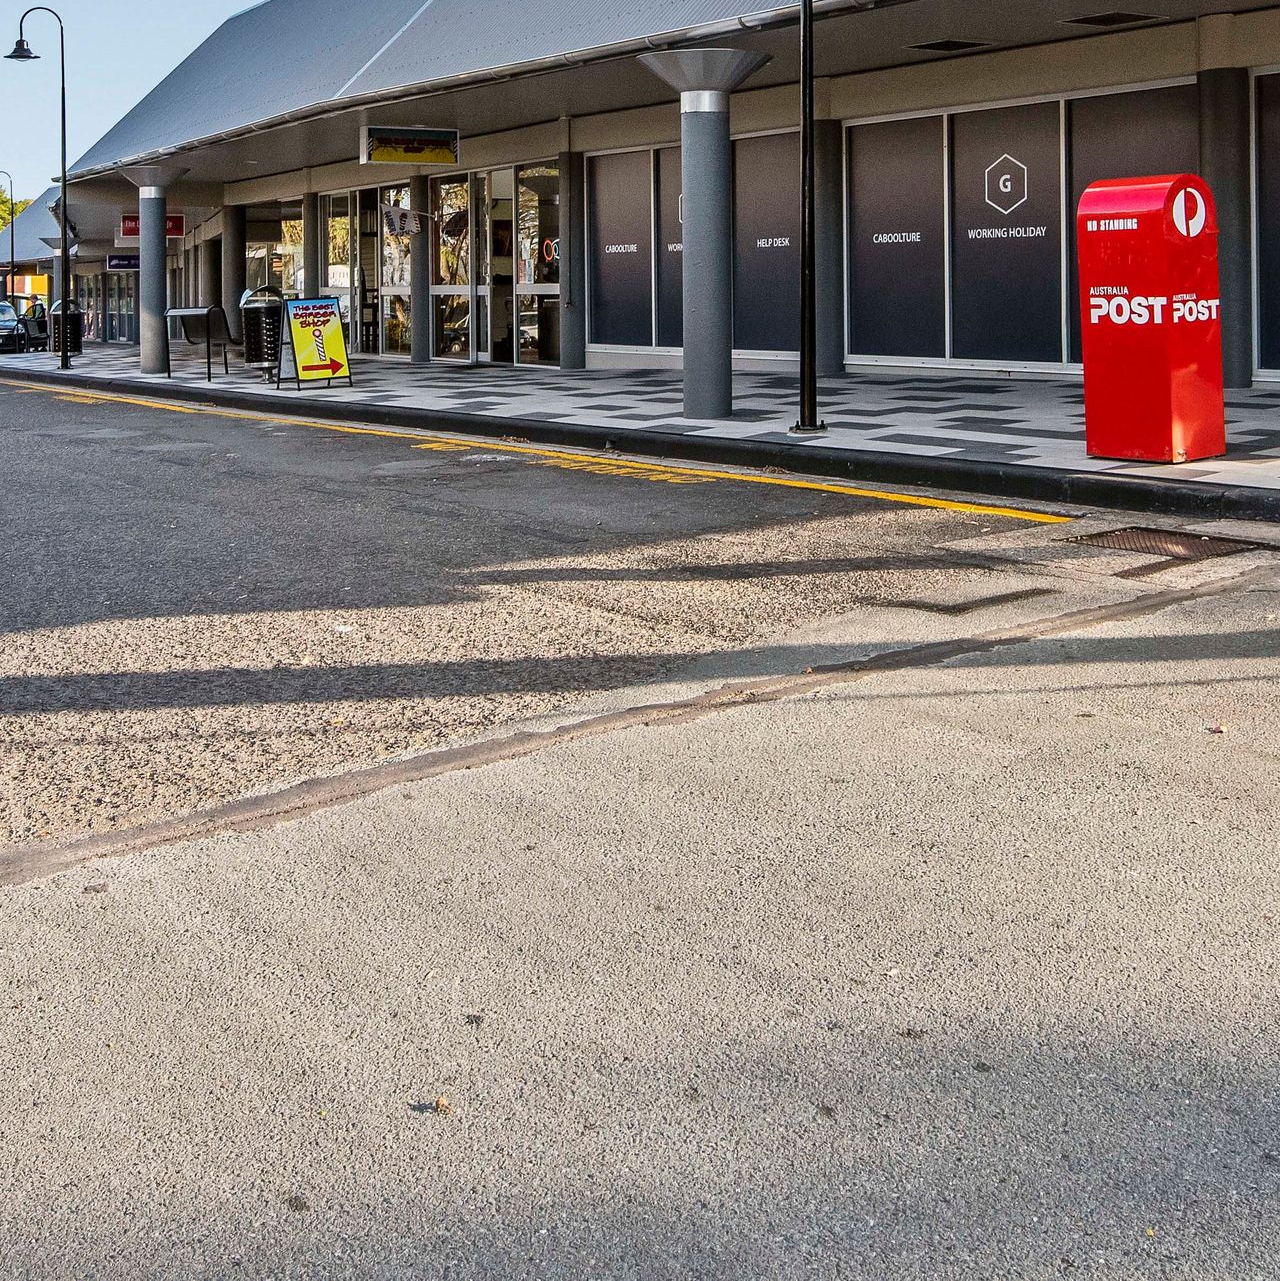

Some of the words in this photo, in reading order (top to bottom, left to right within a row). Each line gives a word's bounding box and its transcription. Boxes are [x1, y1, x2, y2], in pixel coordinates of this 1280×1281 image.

[998, 174, 1012, 193] G
[1087, 220, 1098, 231] NO
[1100, 218, 1138, 231] STANDING
[873, 232, 921, 243] CABOOLTURE
[968, 227, 1008, 239] WORKING
[1009, 226, 1047, 238] HOLIDAY
[757, 238, 772, 248] HELP
[773, 237, 790, 248] DESK
[605, 243, 638, 254] CABOOLTURE
[1089, 286, 1129, 295] AUSTRALIA
[1173, 293, 1197, 301] AUSTRALIA
[1090, 296, 1167, 324] POST
[1173, 299, 1220, 323] POST
[299, 319, 331, 329] SHOP
